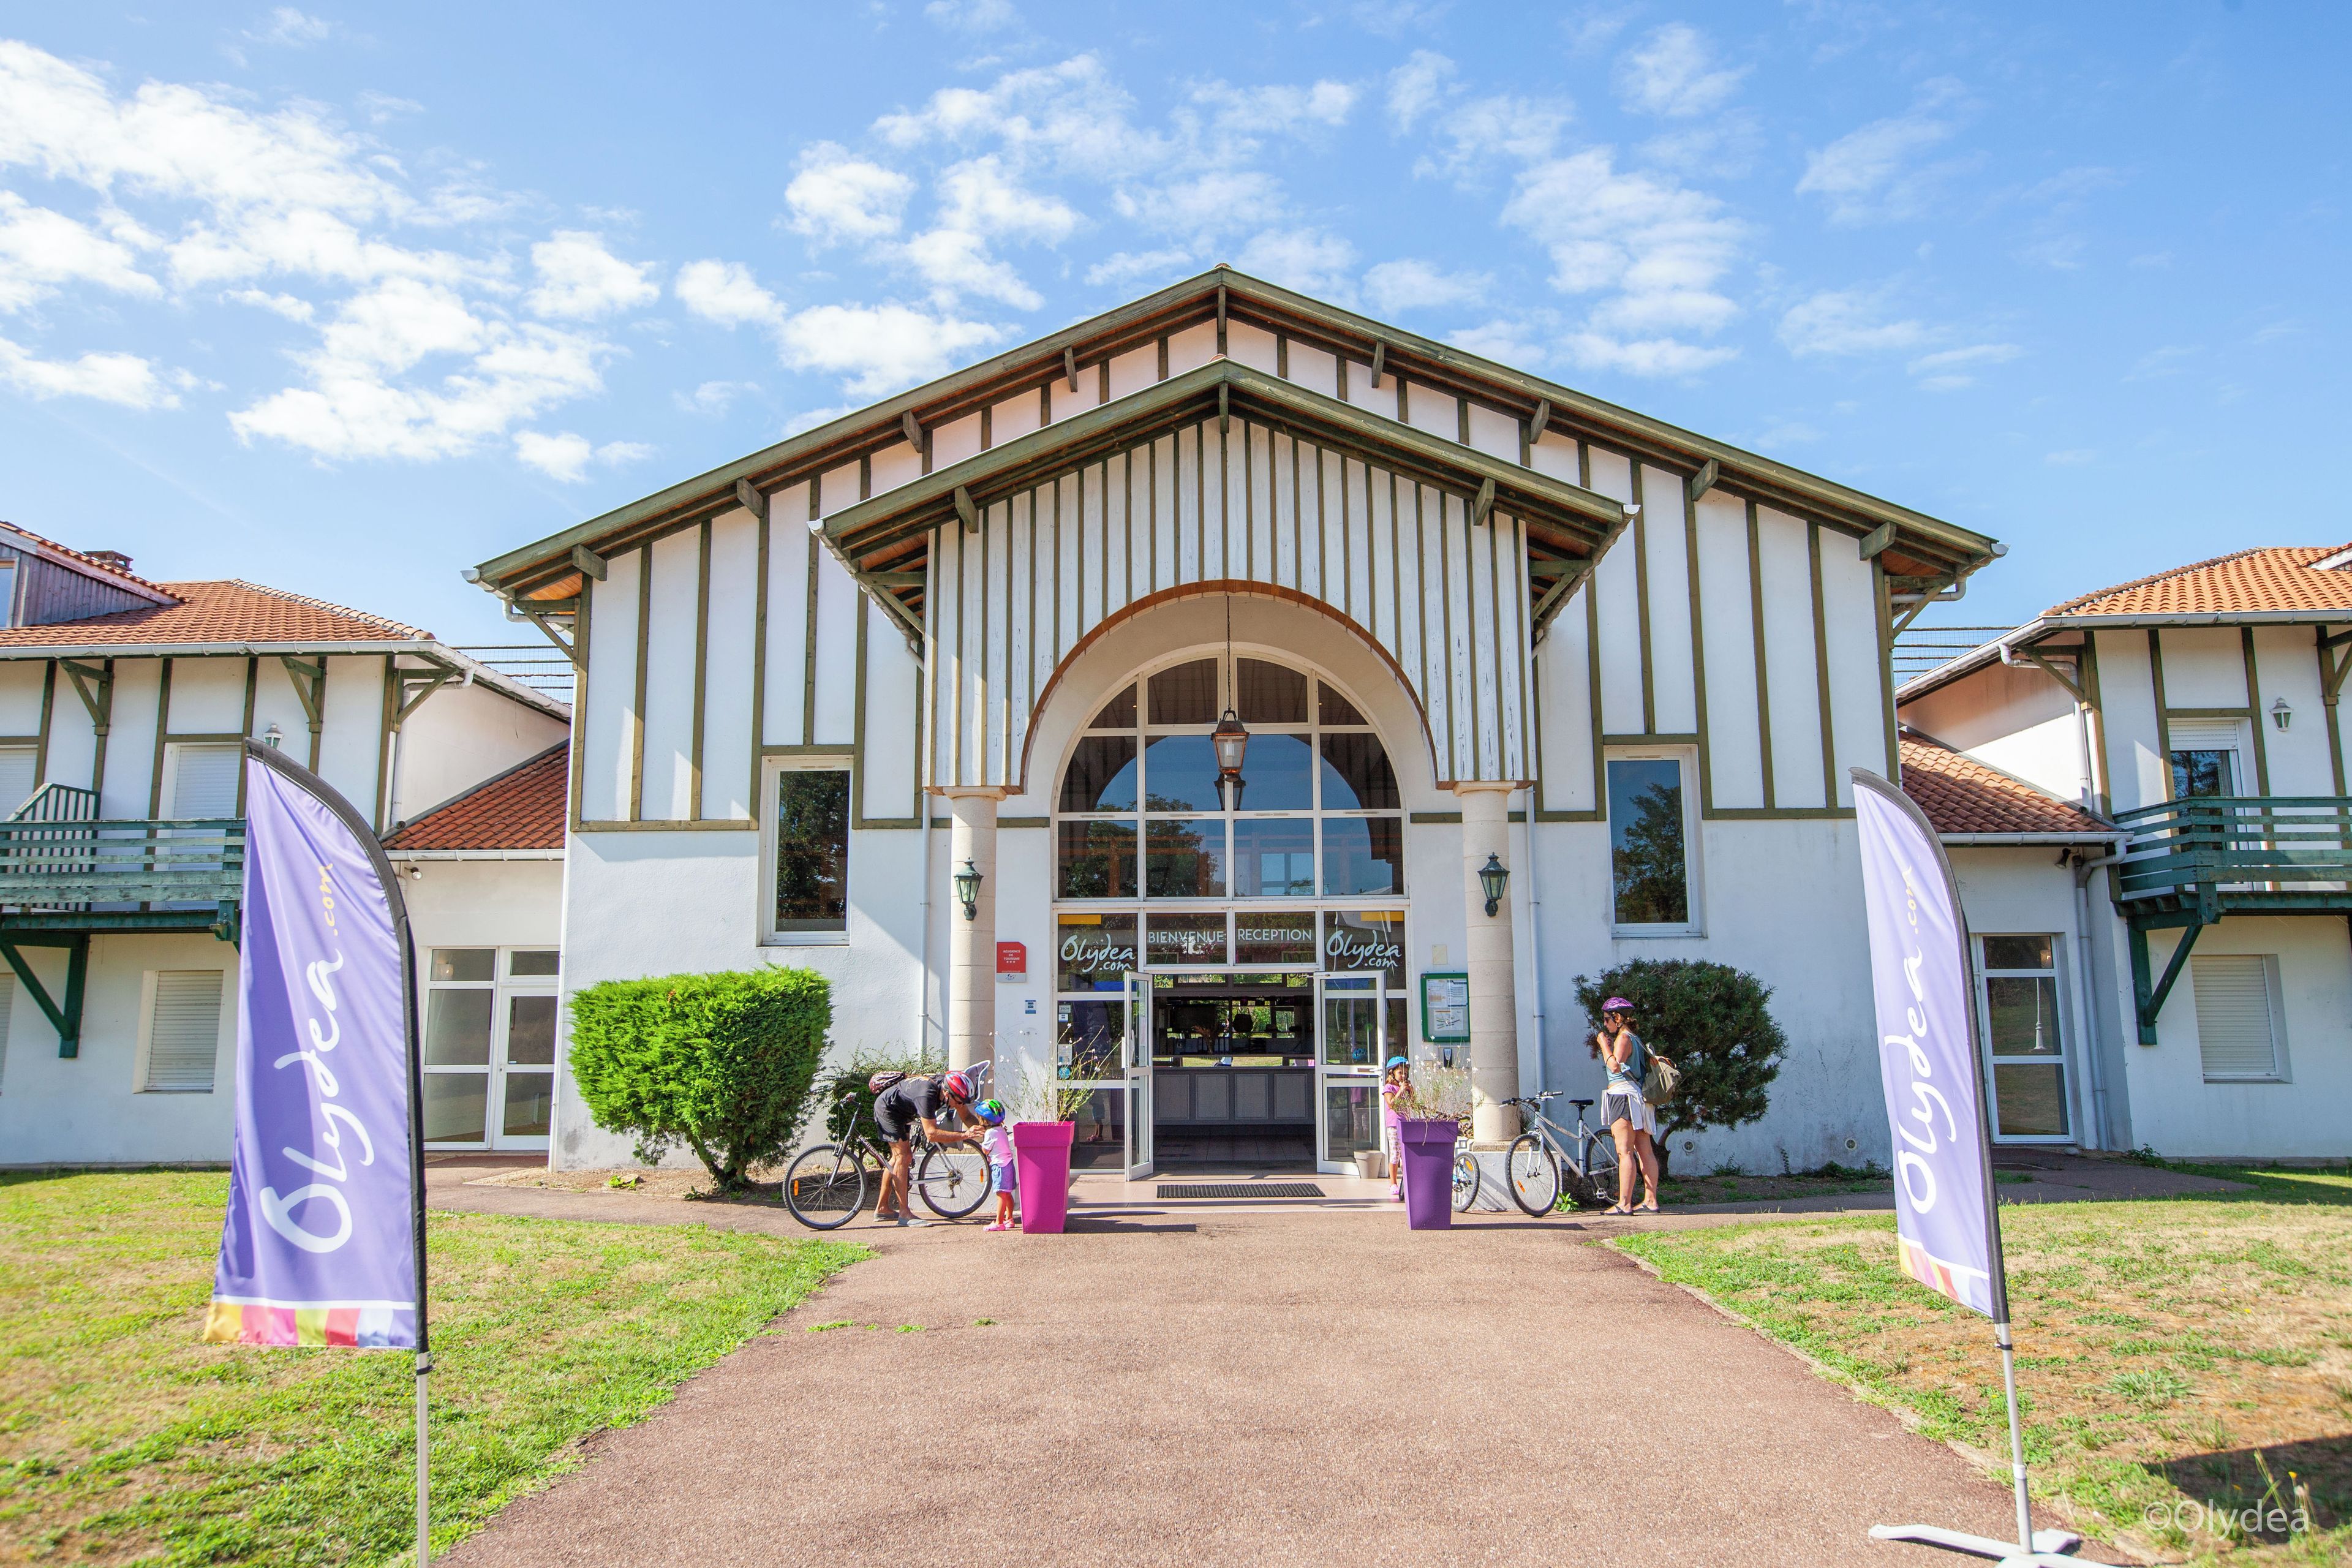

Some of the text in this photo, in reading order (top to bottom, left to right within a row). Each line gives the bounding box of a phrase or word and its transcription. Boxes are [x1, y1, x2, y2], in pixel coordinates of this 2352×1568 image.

[1147, 930, 1225, 943] BIENVENUE
[1237, 928, 1312, 941] RECEPTION
[1060, 933, 1136, 973] Olydea
[1326, 929, 1403, 968] Olydea
[1099, 961, 1133, 971] .com
[1364, 957, 1398, 967] .com
[1884, 864, 1956, 1215] Olydea .com
[259, 862, 374, 1253] Olydea .com
